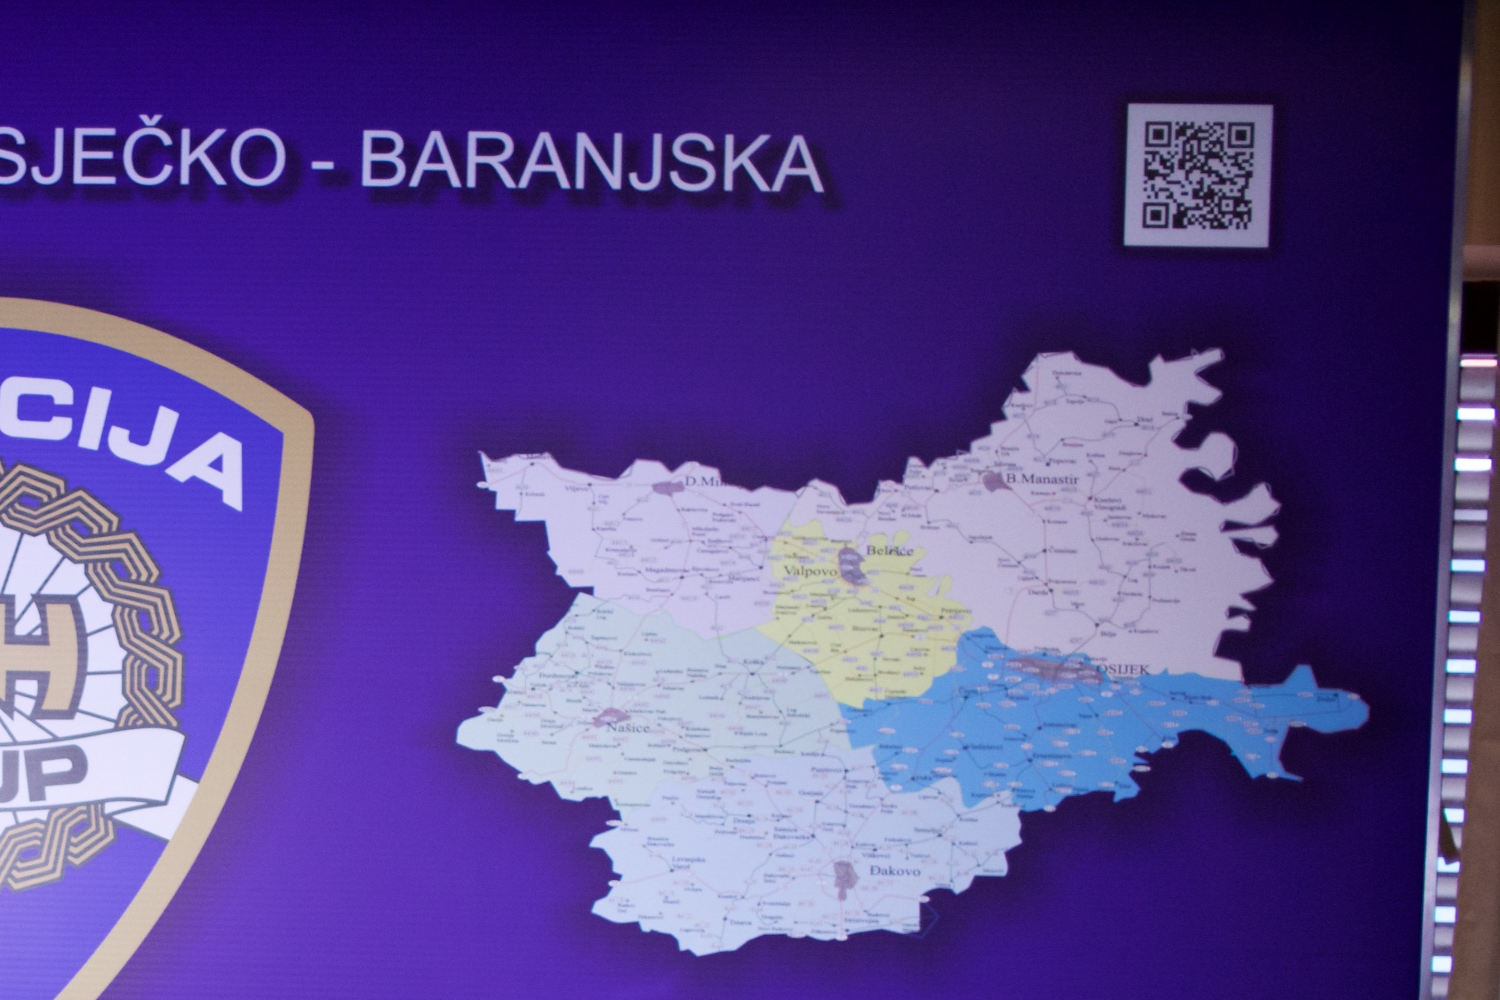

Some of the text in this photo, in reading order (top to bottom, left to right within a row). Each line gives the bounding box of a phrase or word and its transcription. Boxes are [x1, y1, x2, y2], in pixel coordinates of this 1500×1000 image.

[310, 158, 335, 171] -
[360, 131, 827, 194] BARANJSKA
[784, 564, 838, 579] Valpovo
[1096, 663, 1150, 676] OSIJEK
[869, 864, 922, 878] Đakovo
